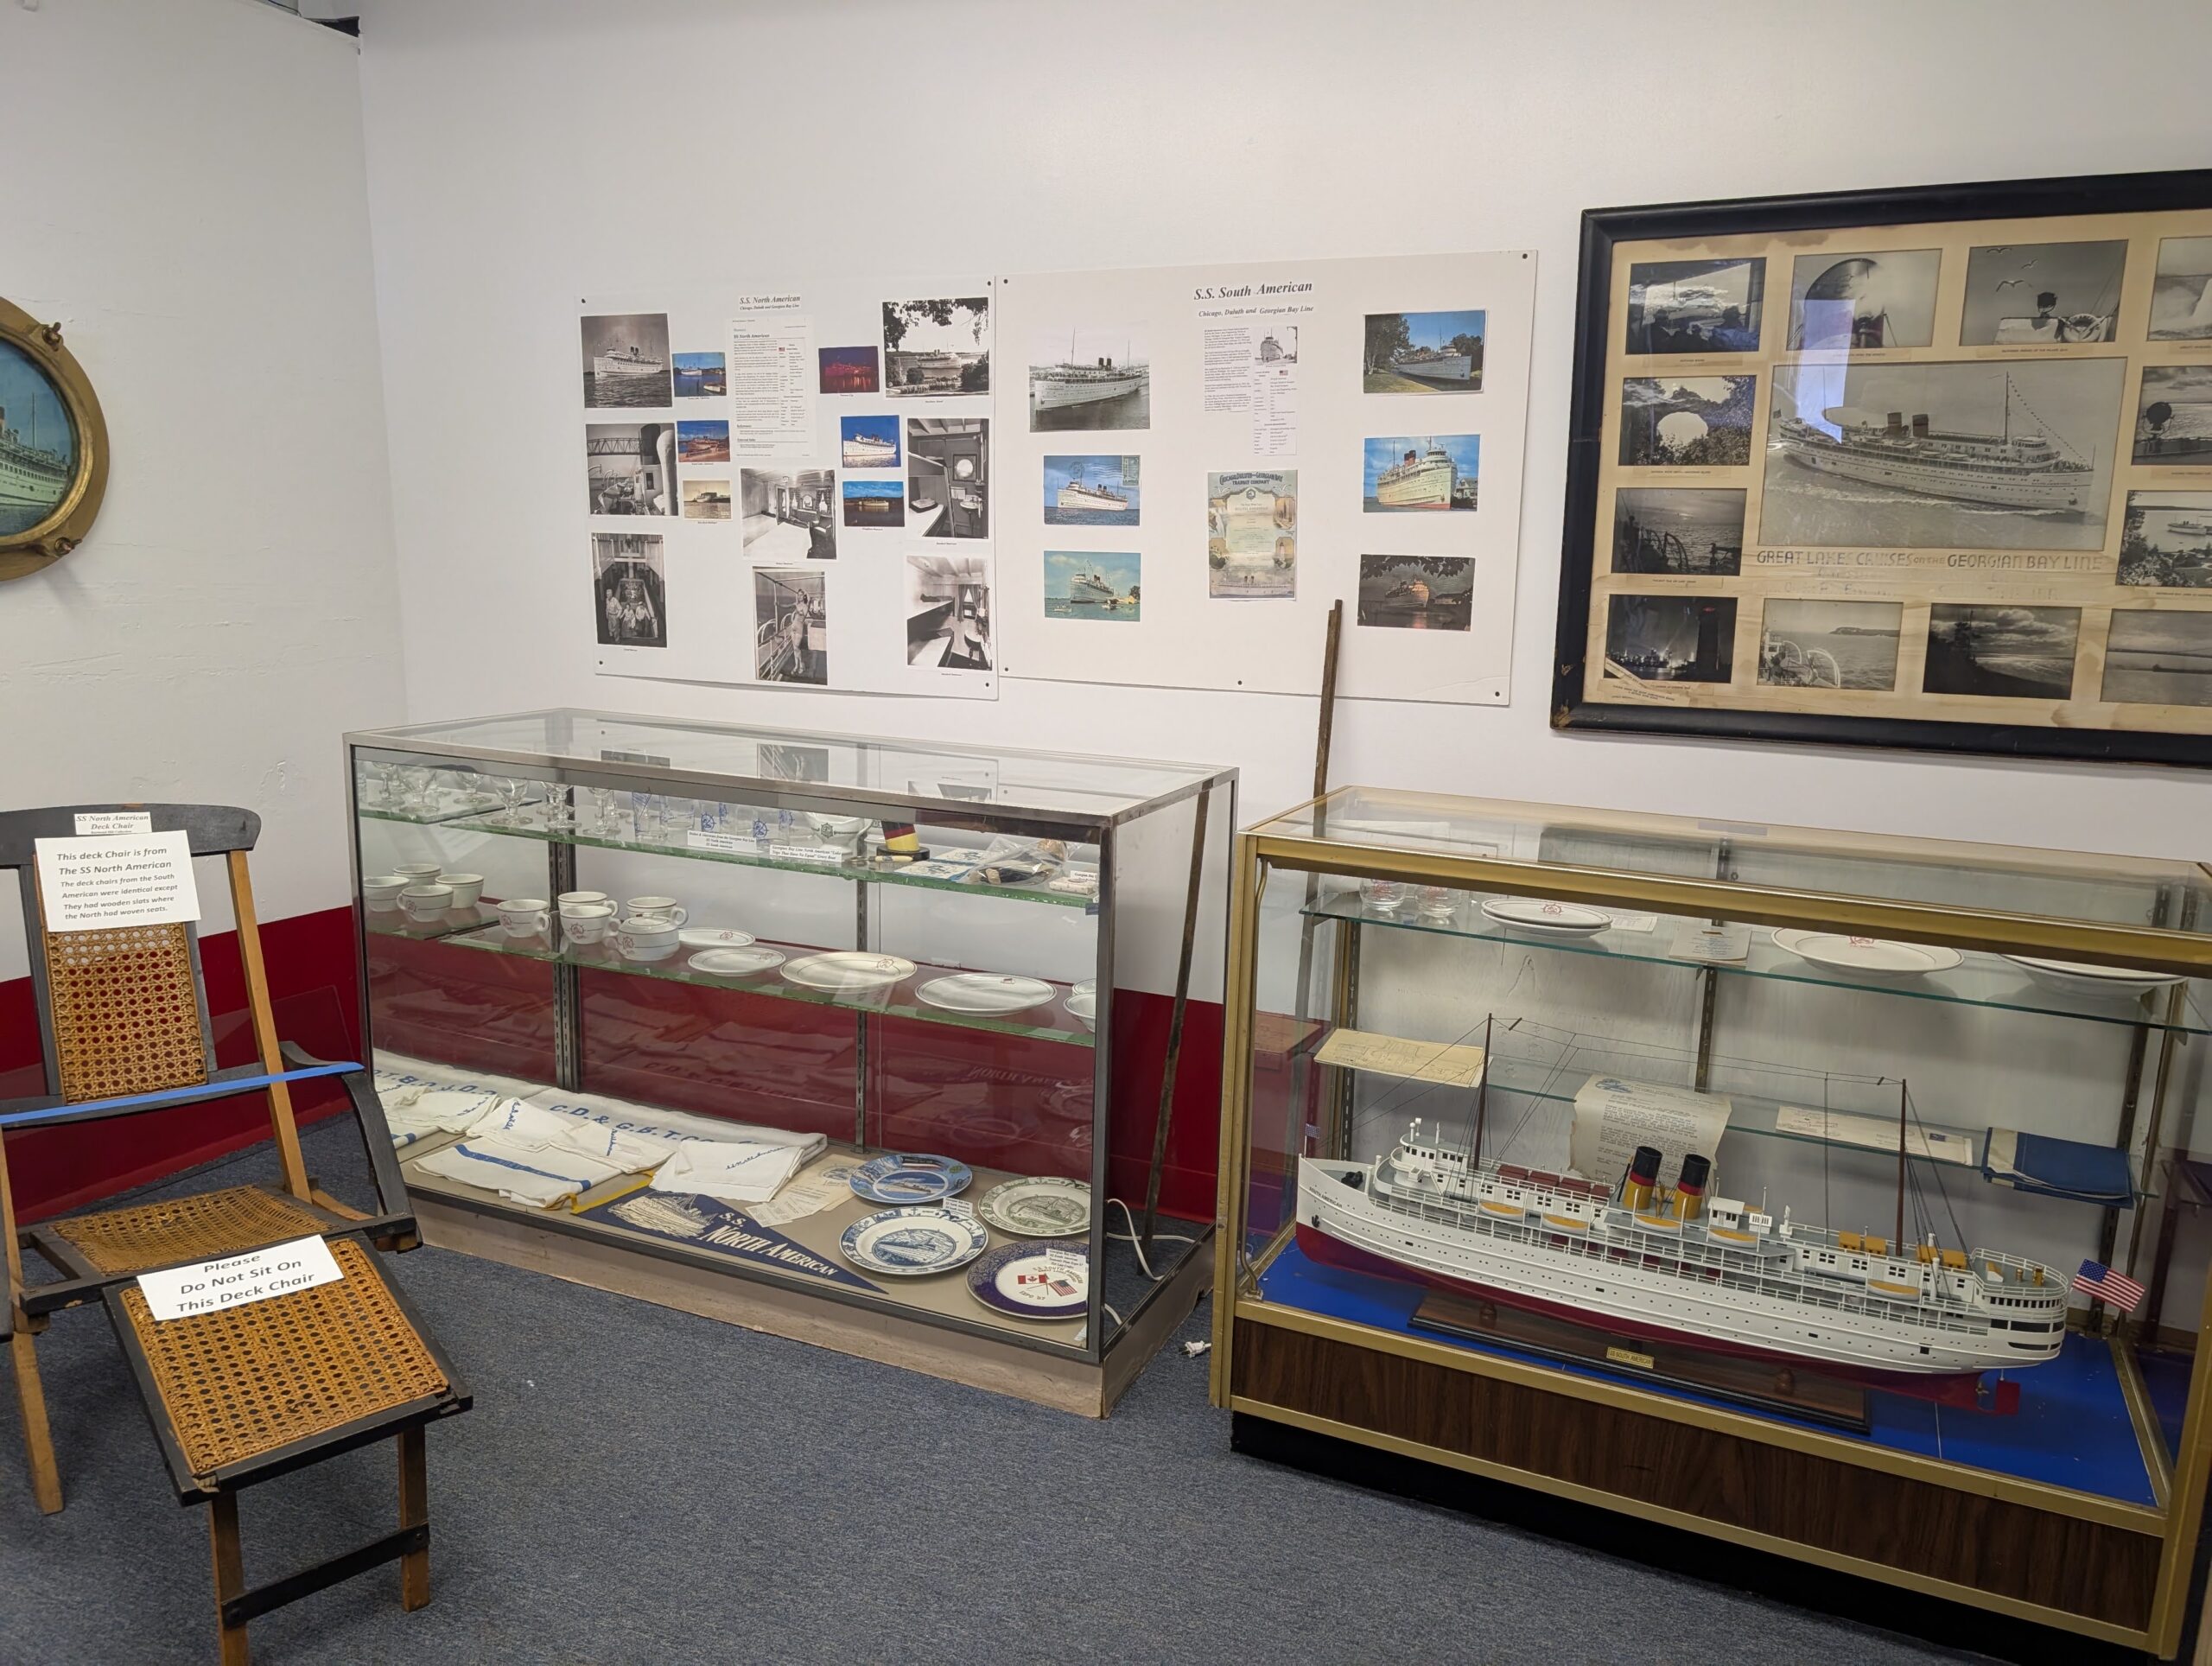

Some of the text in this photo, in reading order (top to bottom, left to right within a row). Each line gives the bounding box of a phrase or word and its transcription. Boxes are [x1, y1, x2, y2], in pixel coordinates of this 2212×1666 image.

[1194, 281, 1313, 301] S.S. South American
[753, 296, 770, 304] North
[771, 295, 800, 303] American
[1260, 307, 1286, 315] Georgian
[1757, 550, 1804, 564] GREAT
[1948, 554, 2022, 569] GEORGIAN
[2026, 555, 2061, 569] BAY
[2063, 556, 2102, 570] LINE
[79, 851, 103, 860] deck
[105, 849, 131, 858] Chair
[143, 848, 167, 857] from
[80, 866, 92, 874] SS
[94, 865, 123, 874] North
[125, 861, 172, 871] American
[119, 876, 138, 886] from
[154, 873, 175, 881] South
[121, 886, 153, 894] identical
[154, 884, 179, 893] except
[100, 899, 131, 907] wooden
[719, 1211, 747, 1228] S.S.
[699, 1224, 839, 1276] NORTH AMERICAN
[204, 1255, 261, 1273] Please
[181, 1260, 302, 1294] Do Not Sit On
[176, 1273, 315, 1313] This Deck Chair
